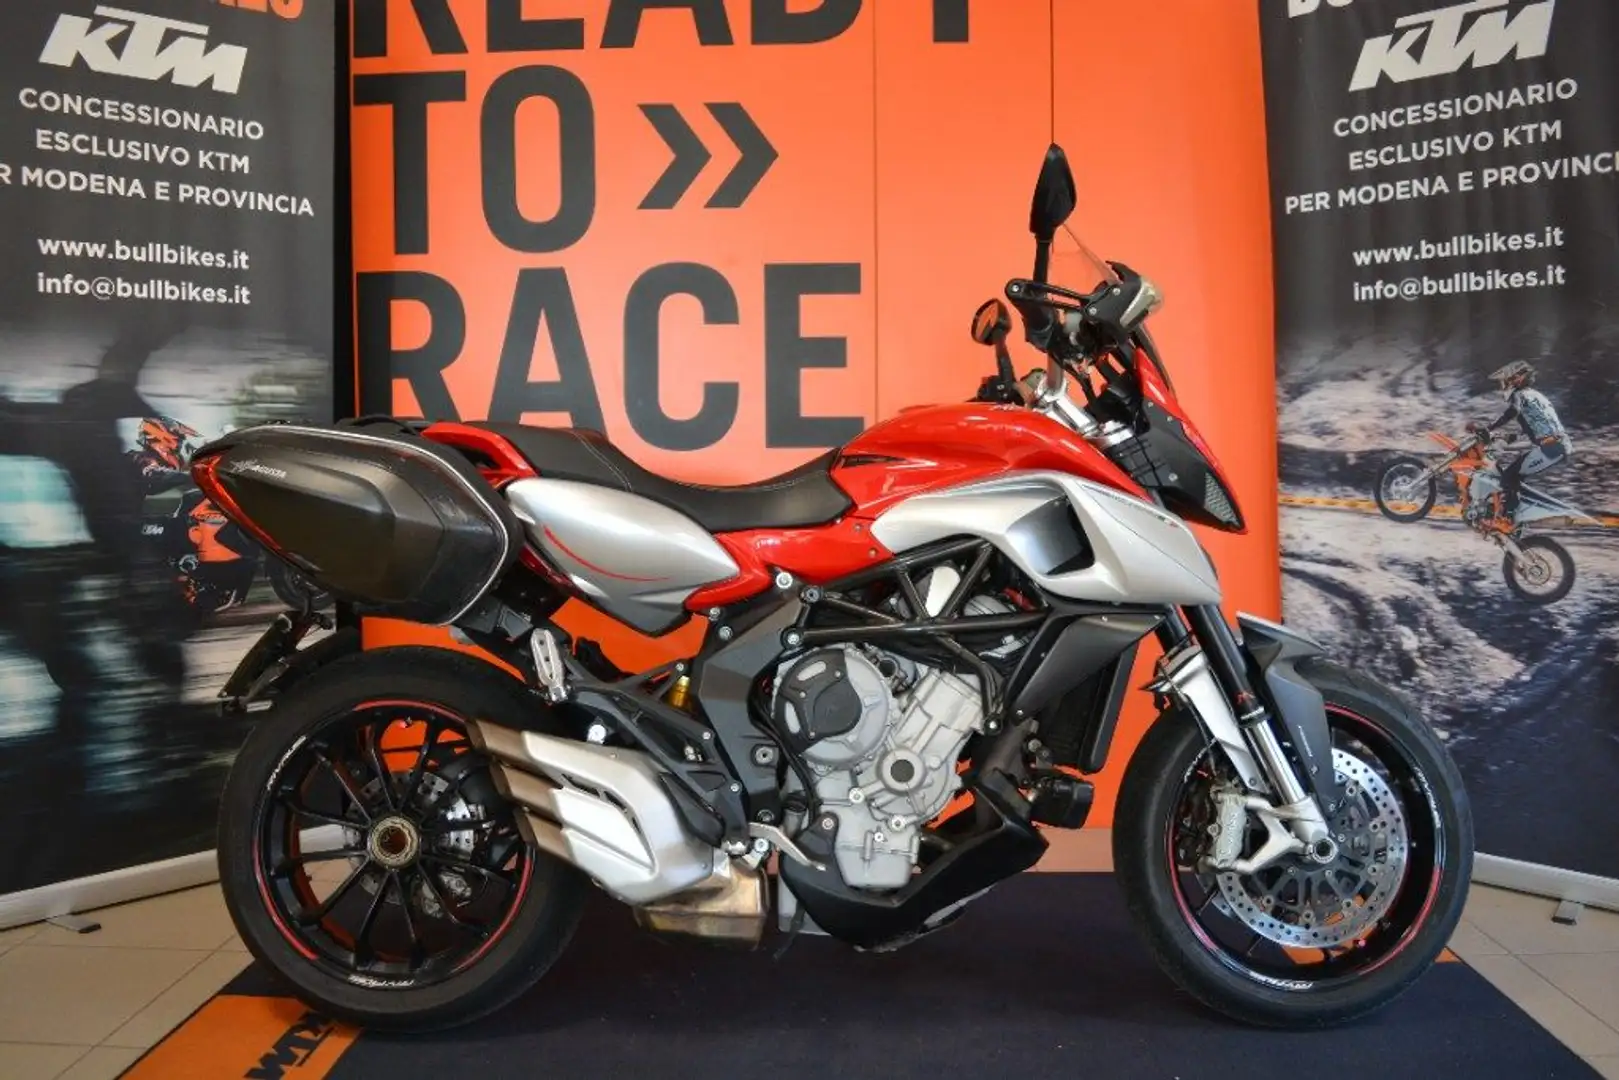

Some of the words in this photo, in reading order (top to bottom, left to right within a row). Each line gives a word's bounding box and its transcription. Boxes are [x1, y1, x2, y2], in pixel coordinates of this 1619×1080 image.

[39, 5, 248, 95] KTM
[1348, 0, 1556, 92] KTM
[18, 87, 264, 141] CONCESSIONARIO
[1333, 77, 1578, 137] CONCESSIONARIO
[36, 128, 190, 167] ESCLUSIVO
[198, 149, 250, 175] KTM
[354, 64, 597, 255] TO
[1348, 130, 1494, 171] ESCLUSIVO
[1503, 119, 1562, 150] KTM
[21, 165, 146, 199] MODENA
[154, 180, 171, 203] E
[178, 183, 315, 217] PROVINCIA
[1285, 191, 1331, 215] PER
[1337, 175, 1450, 208] MODENA
[1457, 171, 1474, 192] E
[37, 237, 250, 270] www.bullbikes.it
[1352, 226, 1564, 267] www.bullbikes.it
[37, 271, 251, 305] info@bullbikes.it
[1353, 264, 1566, 302] info@bullbikes.it
[356, 262, 865, 451] RACE
